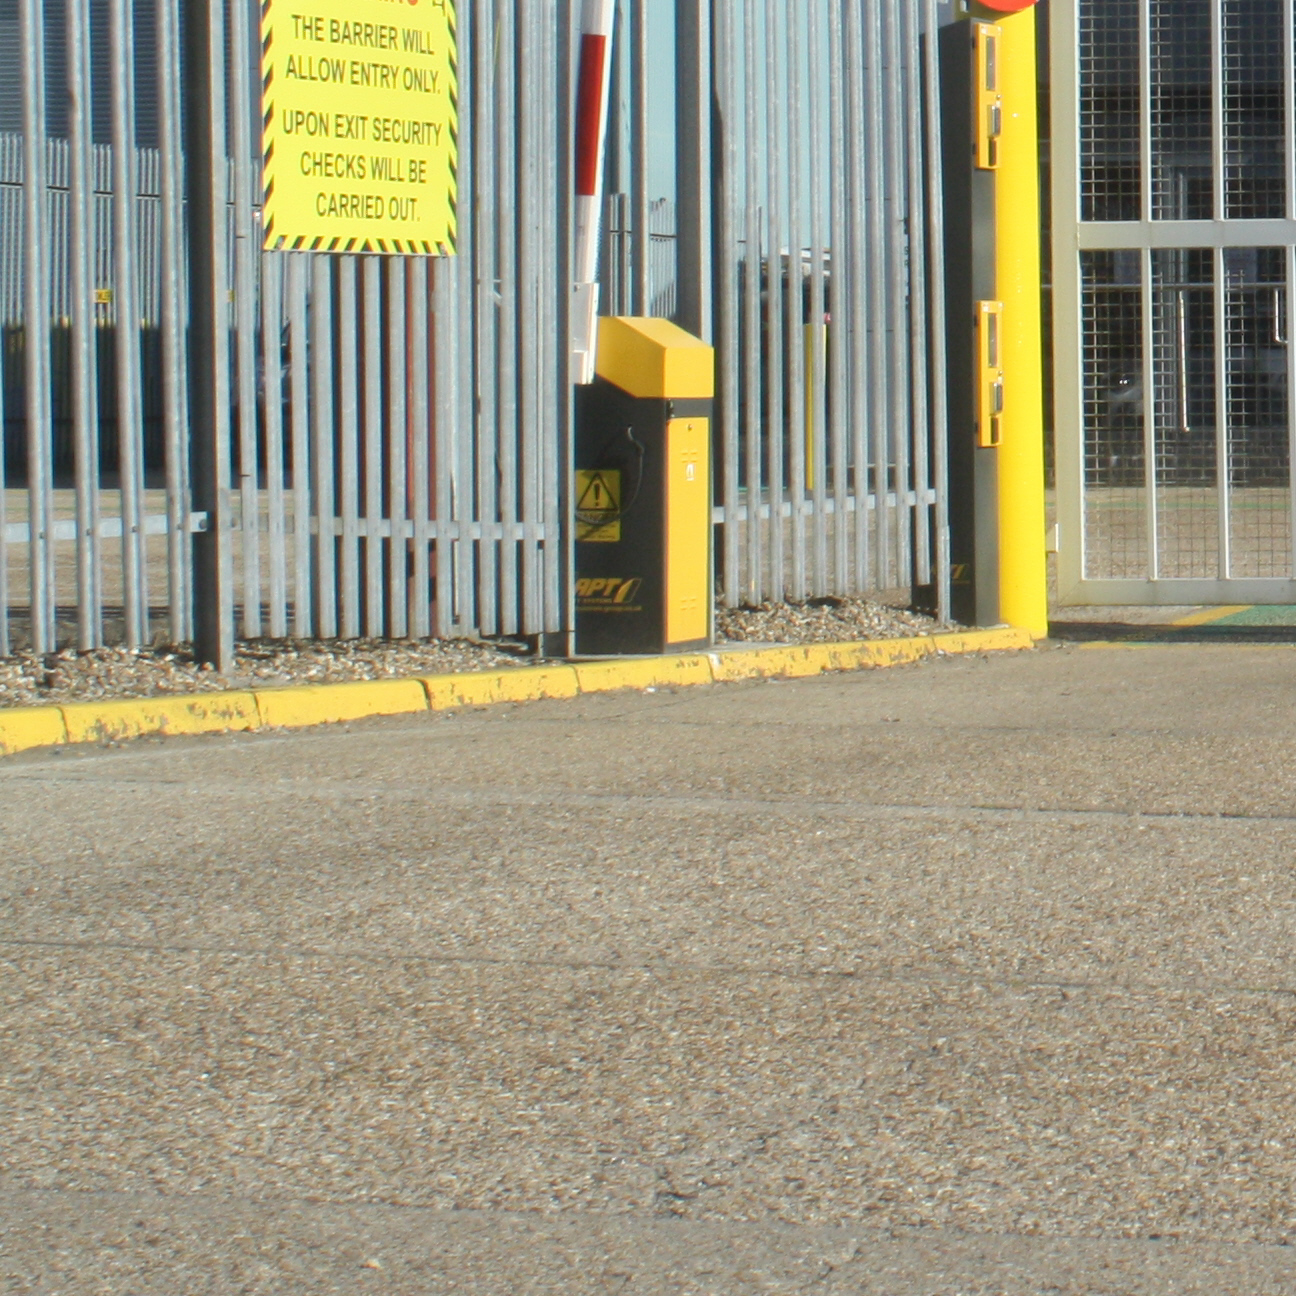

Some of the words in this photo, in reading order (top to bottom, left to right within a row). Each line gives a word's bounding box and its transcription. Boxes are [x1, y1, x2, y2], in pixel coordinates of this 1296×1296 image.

[291, 14, 325, 42] THE
[330, 19, 398, 51] BARRIER
[402, 28, 435, 55] WILL
[285, 54, 346, 84] ALLOW
[350, 61, 399, 89] ENTRY
[402, 66, 441, 94] ONLY.
[282, 109, 330, 137] UPON
[334, 114, 368, 140] EXIT
[372, 117, 442, 146] SECURITY
[300, 151, 367, 179] CHECKS
[370, 156, 405, 182] WILL
[408, 159, 427, 184] BE
[316, 192, 385, 219] CARRIED
[388, 196, 420, 222] OUT.
